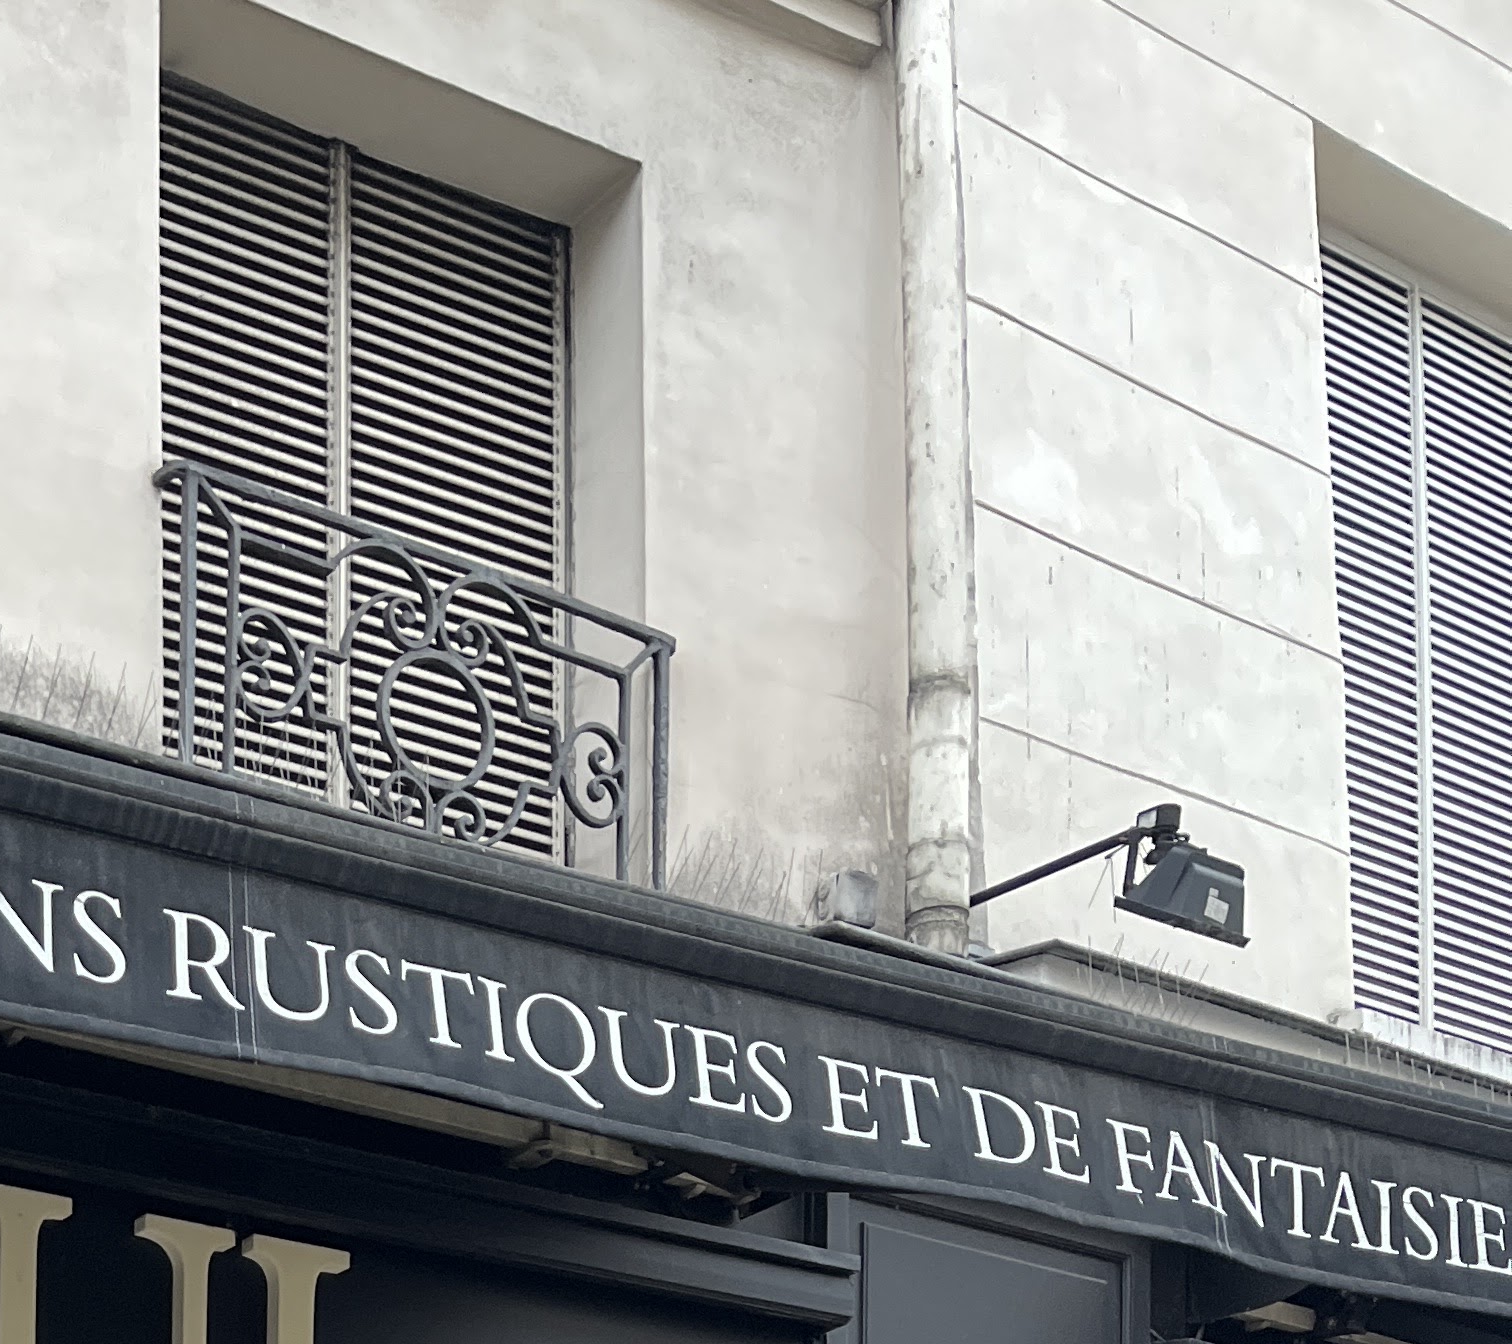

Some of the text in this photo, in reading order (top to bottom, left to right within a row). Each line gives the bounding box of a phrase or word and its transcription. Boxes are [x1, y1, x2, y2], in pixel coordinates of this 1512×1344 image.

[163, 908, 793, 1123] RUSTIQUES
[818, 1055, 939, 1148] ET
[962, 1085, 1090, 1184] DE
[1105, 1118, 1512, 1276] FANTAISIE
